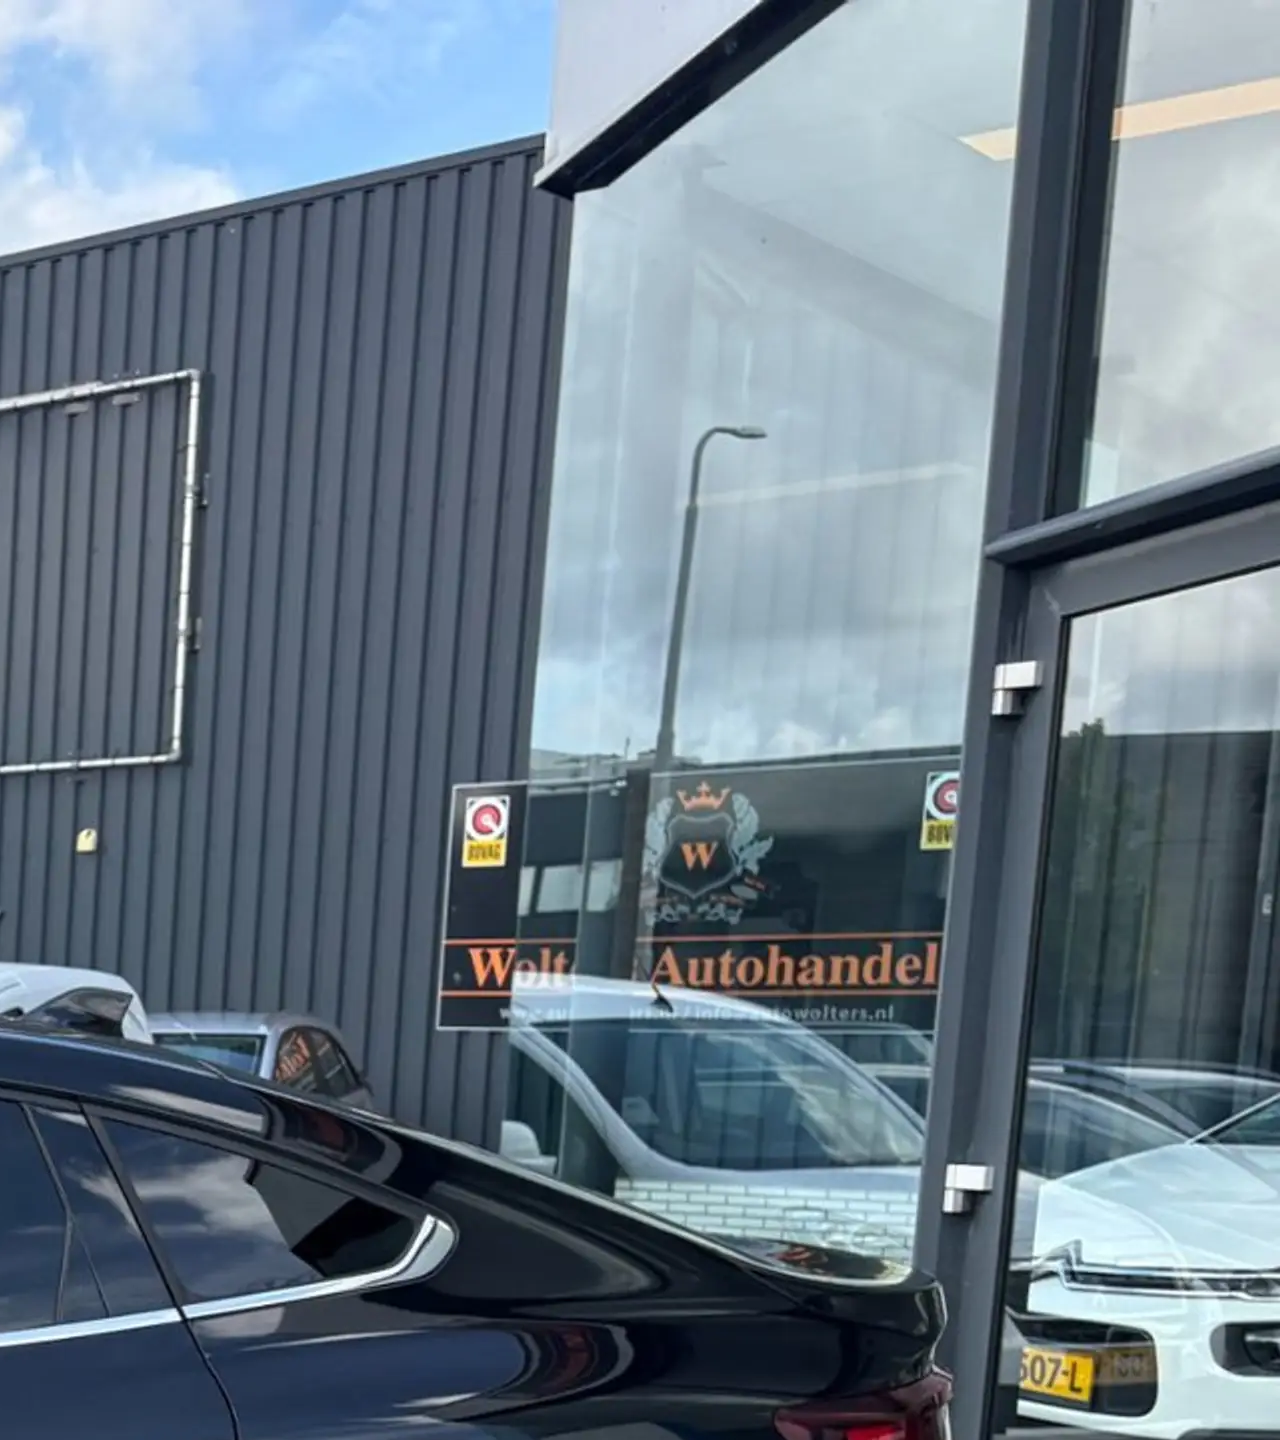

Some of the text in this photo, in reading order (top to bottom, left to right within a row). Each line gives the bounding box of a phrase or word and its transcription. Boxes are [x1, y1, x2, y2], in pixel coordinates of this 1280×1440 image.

[680, 841, 719, 871] W
[468, 944, 939, 989] Wolt Autohandel
